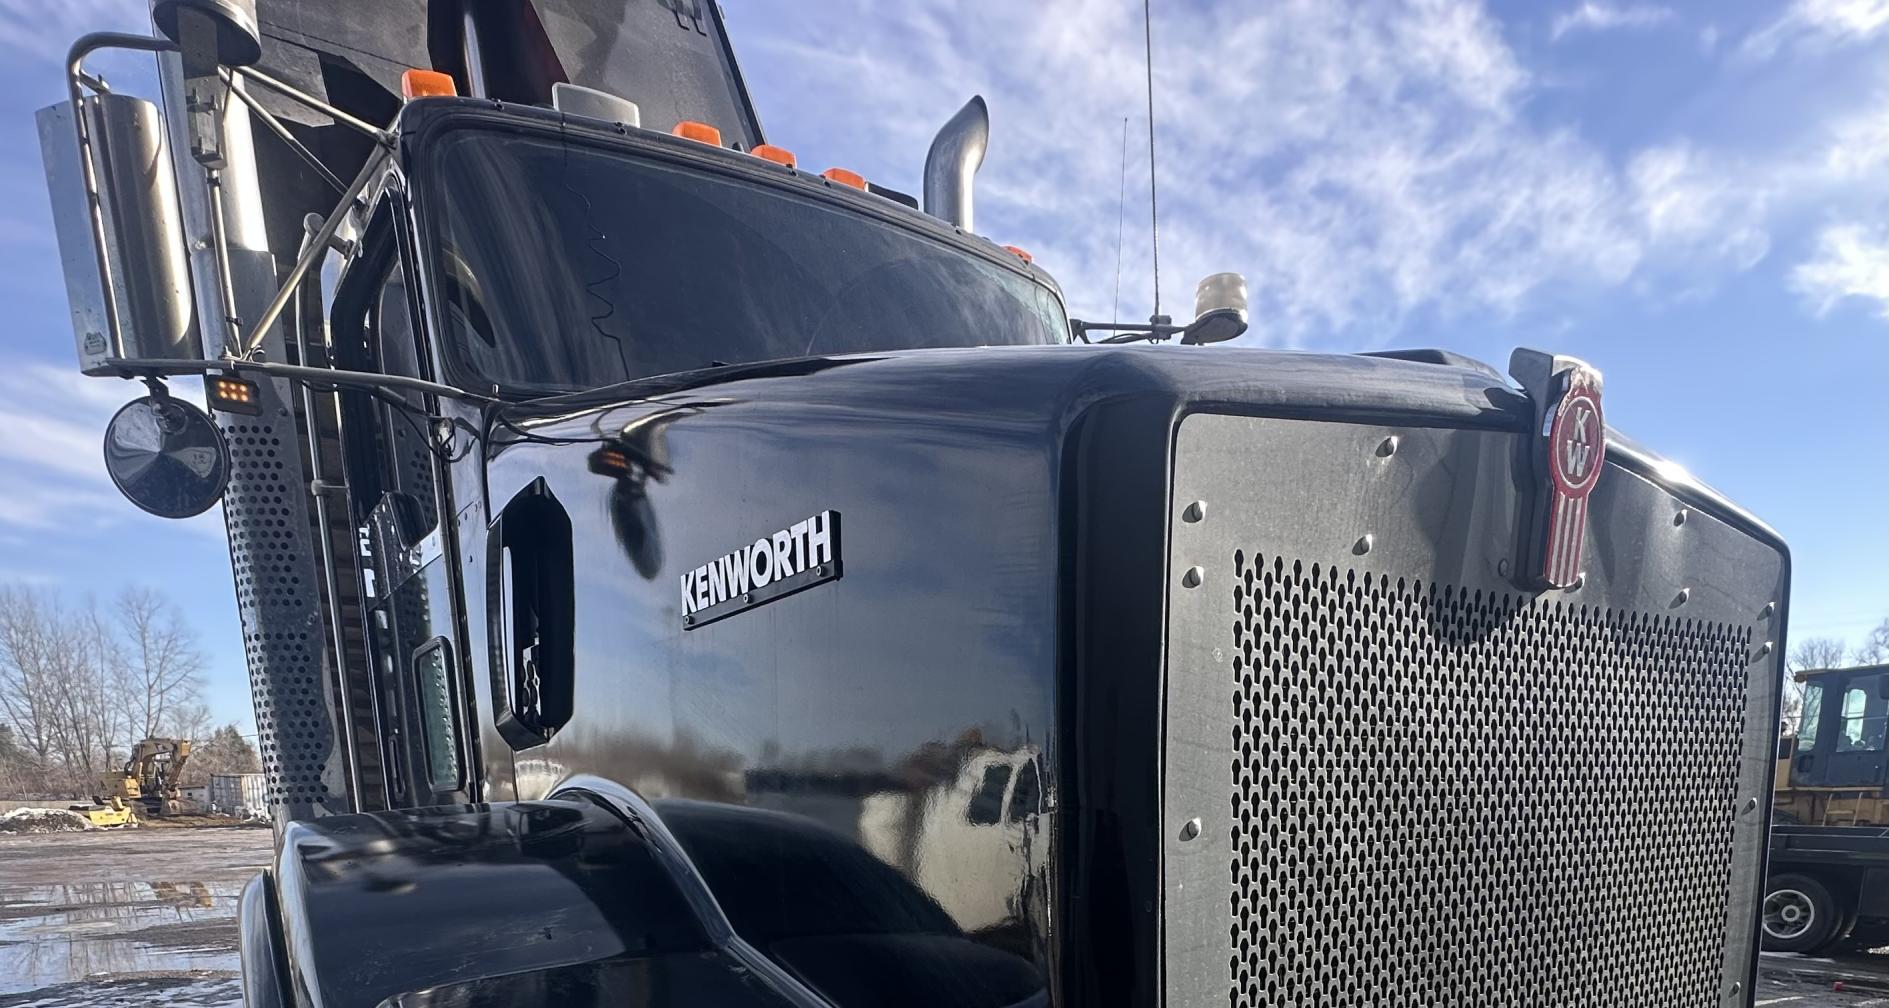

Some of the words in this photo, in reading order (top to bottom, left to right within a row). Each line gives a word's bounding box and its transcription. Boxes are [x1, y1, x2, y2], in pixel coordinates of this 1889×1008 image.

[1574, 407, 1591, 443] K
[1566, 439, 1590, 477] W
[680, 509, 833, 617] KENWORTH
